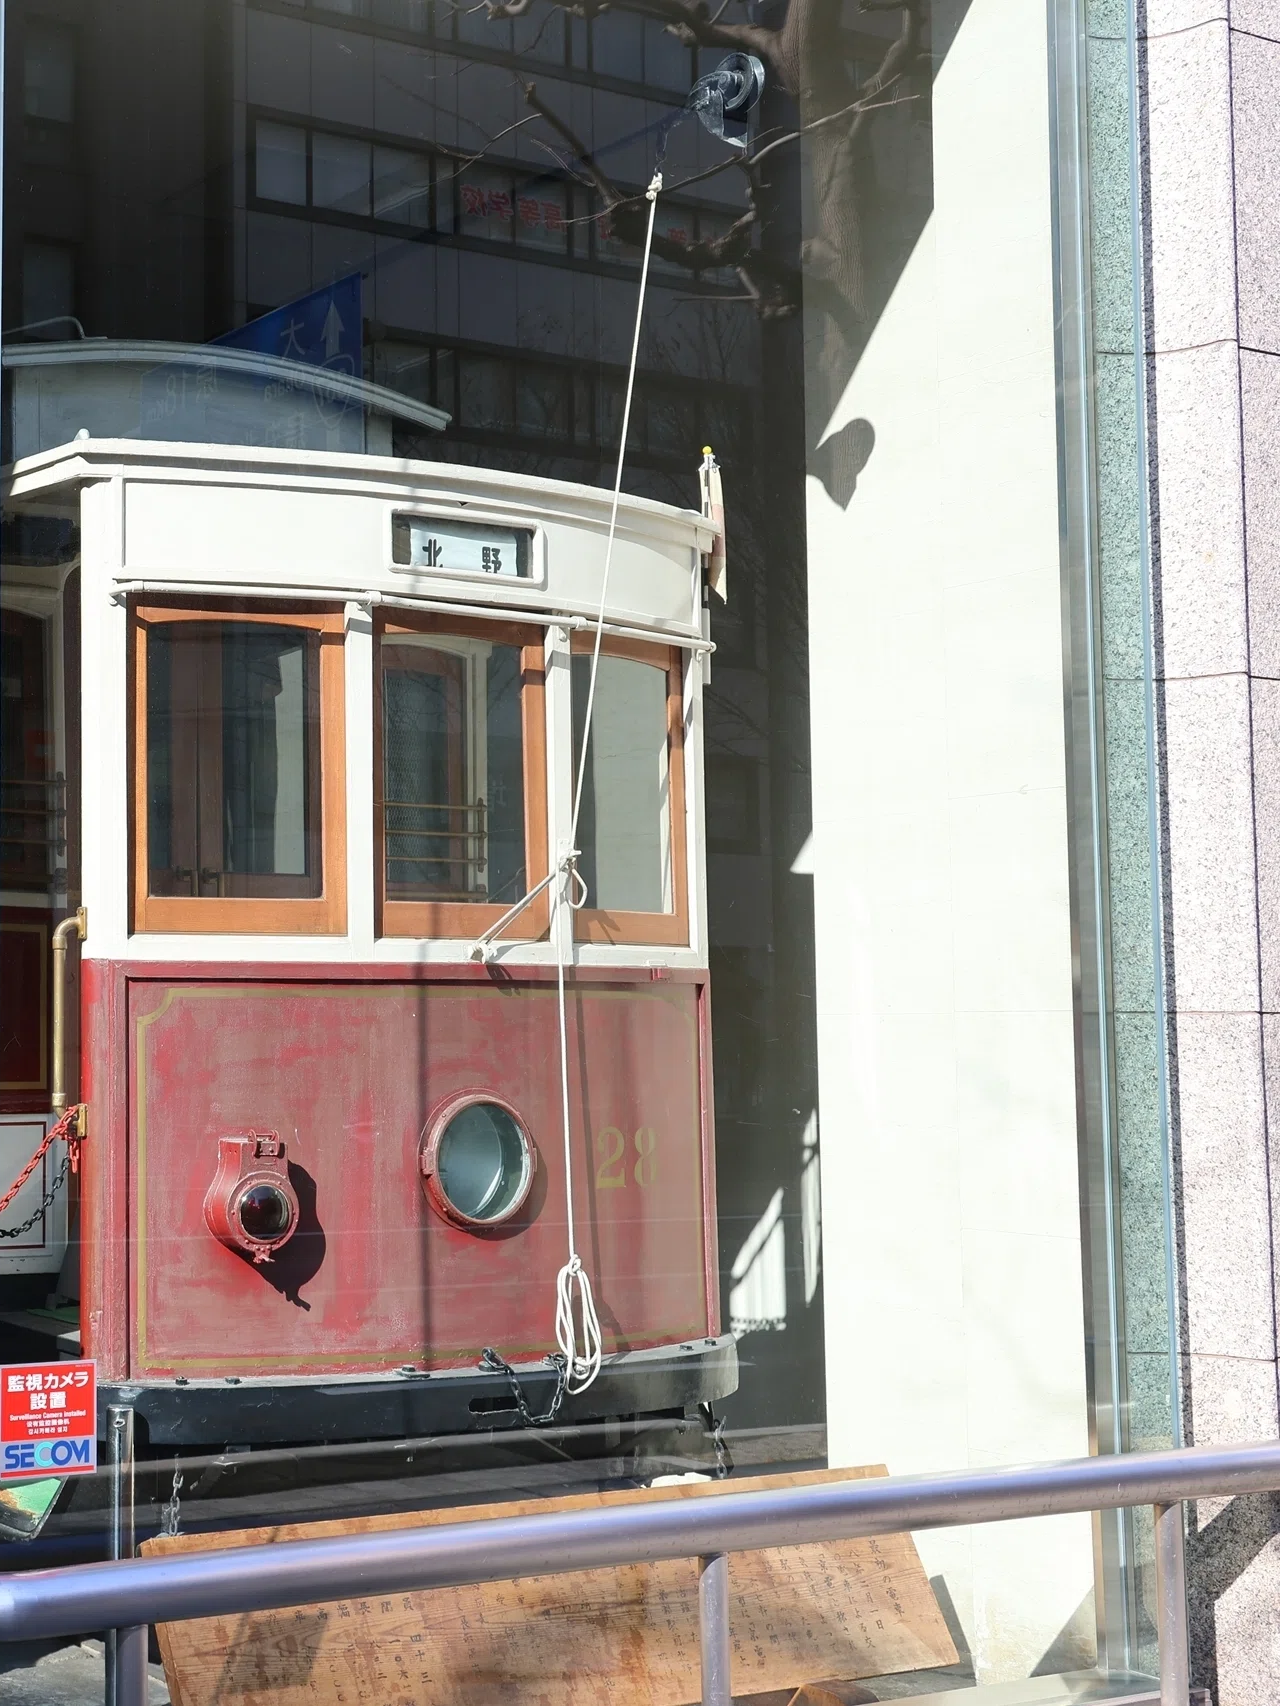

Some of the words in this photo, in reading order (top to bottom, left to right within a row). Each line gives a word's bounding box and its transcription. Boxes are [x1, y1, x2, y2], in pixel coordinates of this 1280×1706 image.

[422, 539, 503, 574] 北野
[596, 1125, 657, 1189] 28
[7, 1371, 89, 1392] 監視カメラ
[30, 1391, 66, 1410] 設置
[42, 1411, 63, 1419] Camera
[4, 1440, 90, 1470] SECOM
